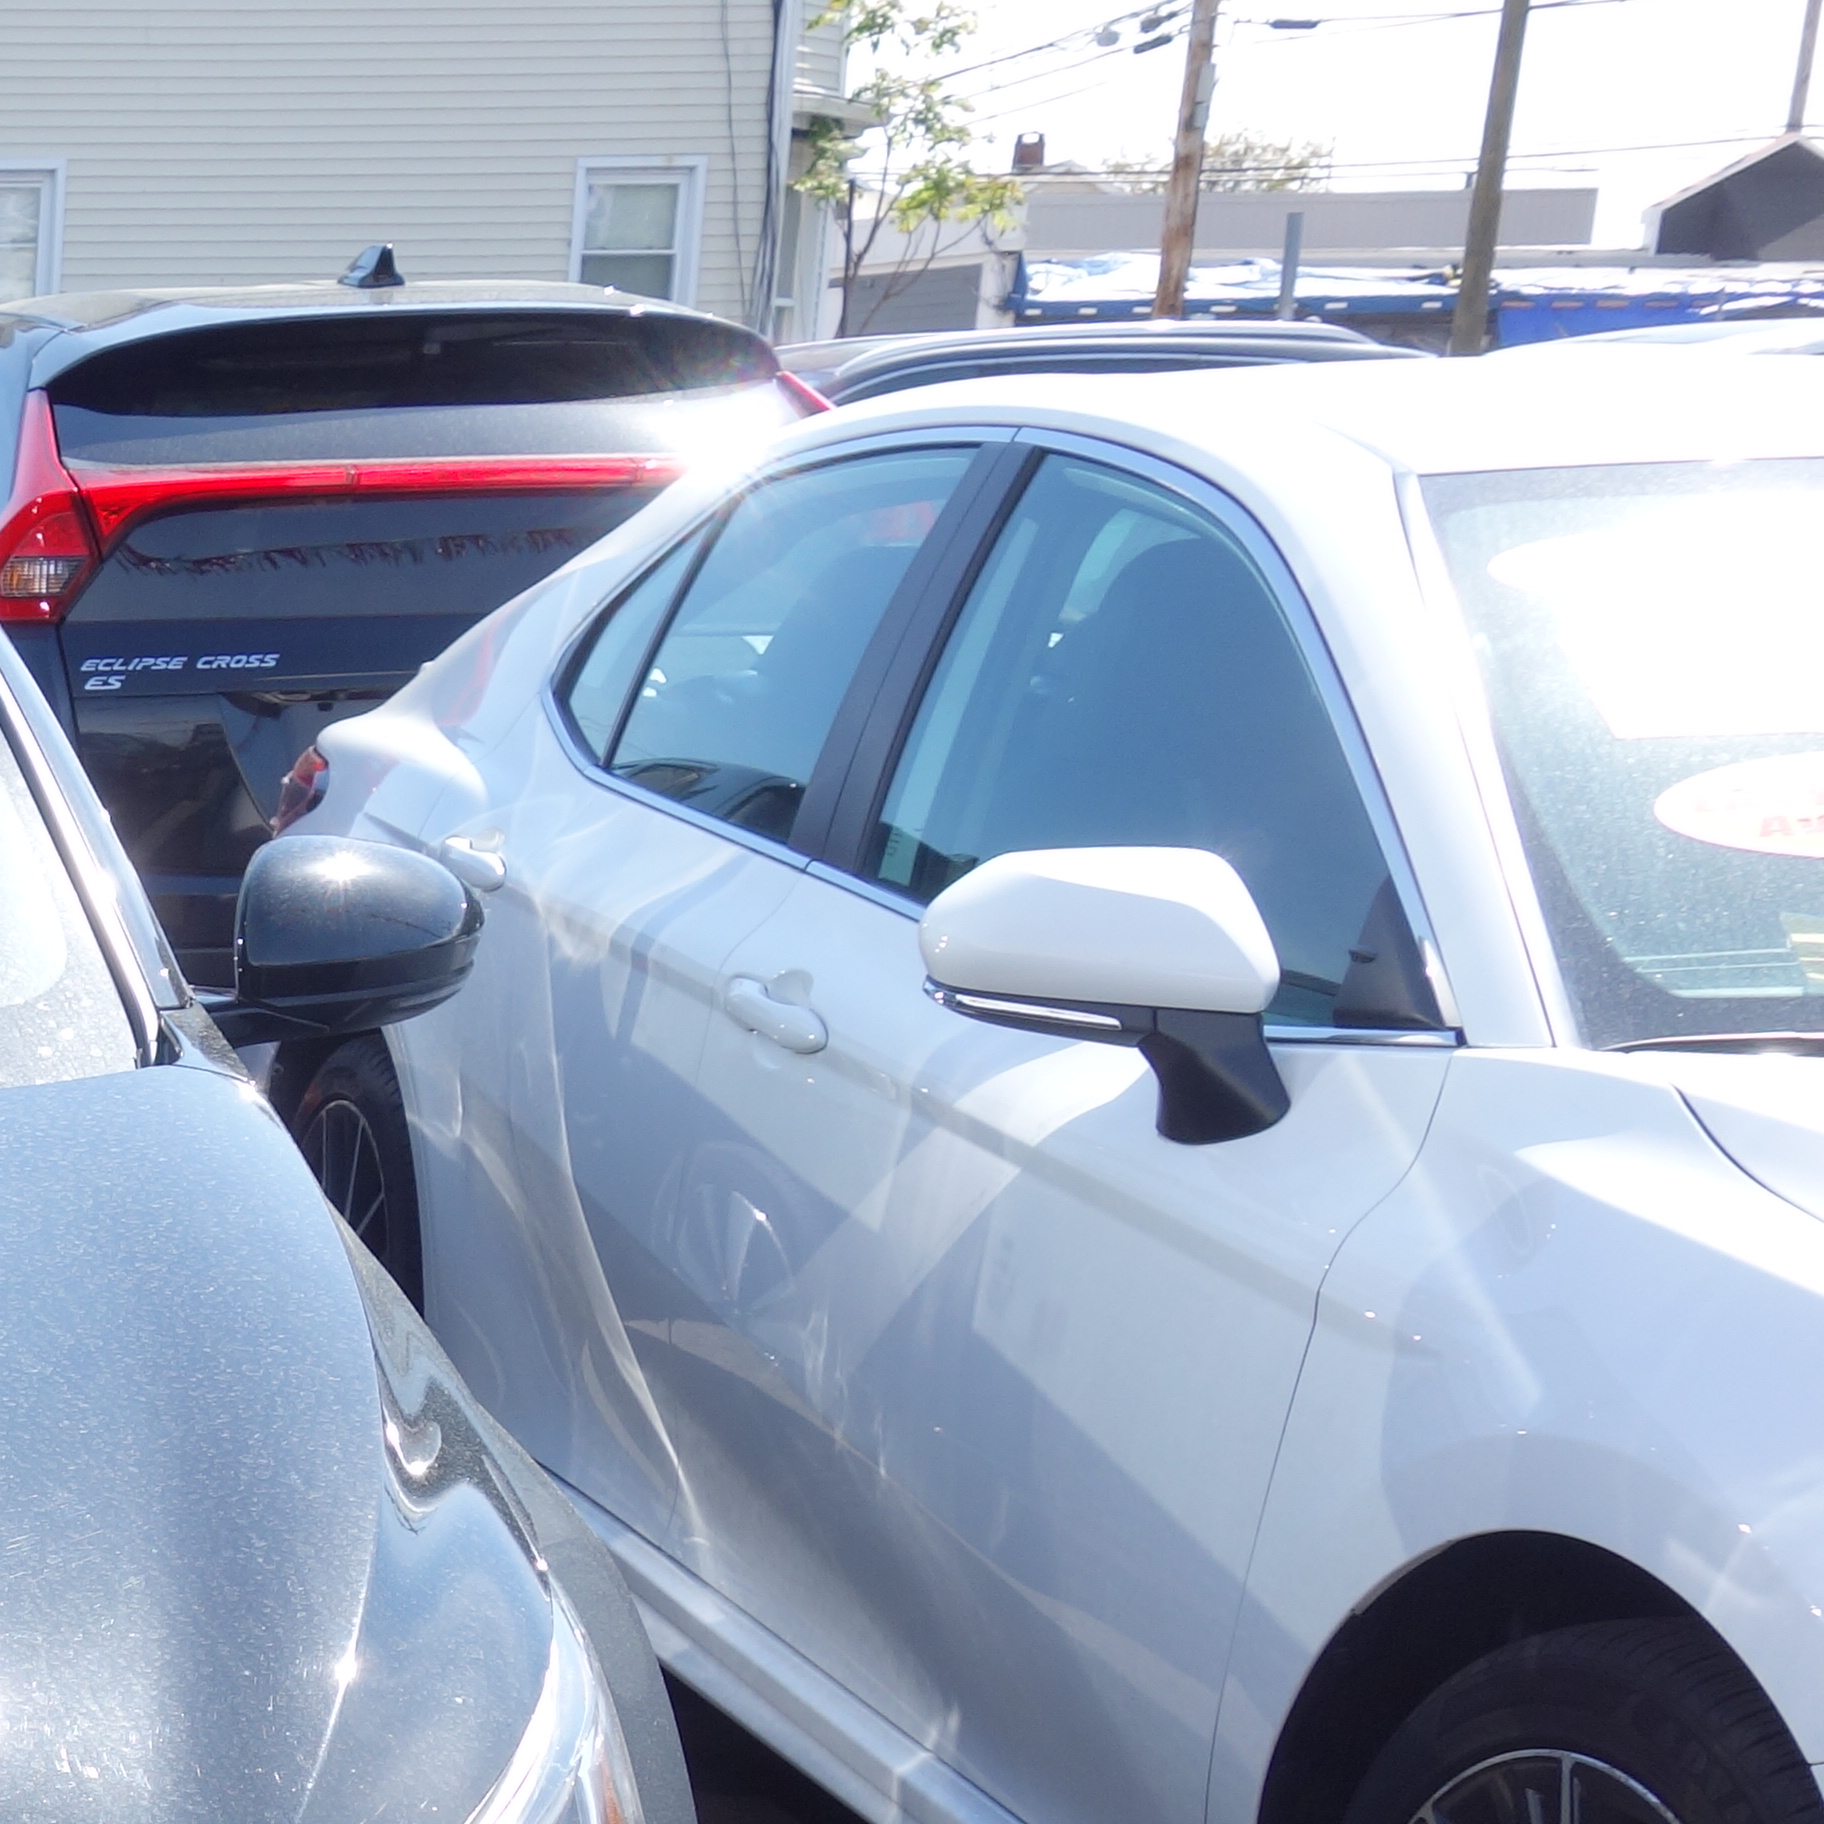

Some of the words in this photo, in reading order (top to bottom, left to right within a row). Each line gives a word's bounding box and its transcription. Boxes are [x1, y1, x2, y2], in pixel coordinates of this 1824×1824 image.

[80, 656, 188, 671] ECLIPSE
[196, 653, 280, 669] CROSS
[84, 675, 126, 690] ES
